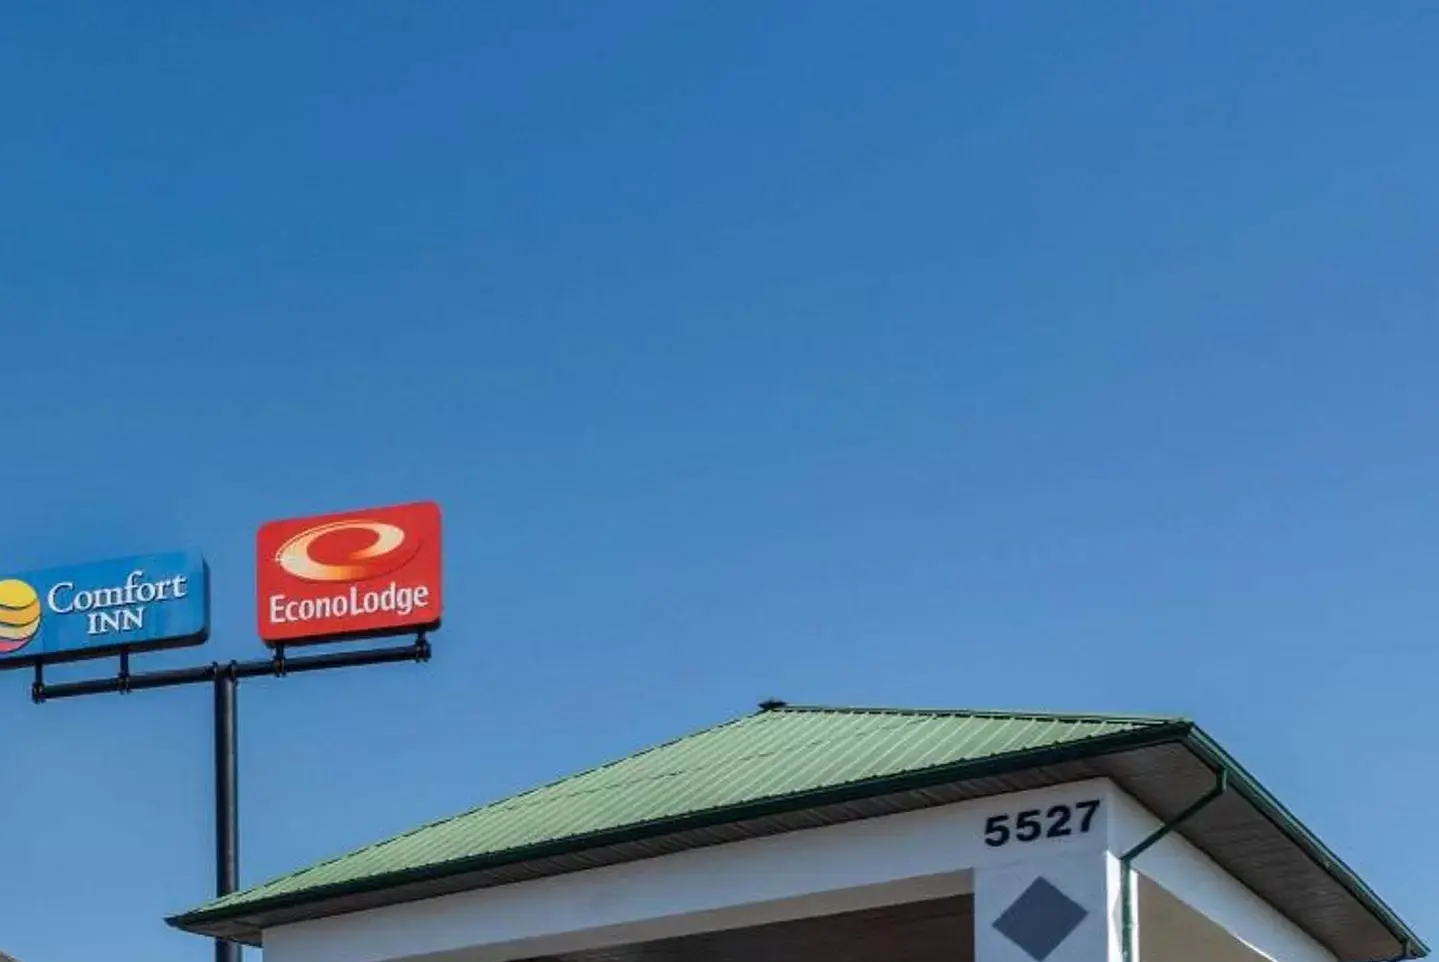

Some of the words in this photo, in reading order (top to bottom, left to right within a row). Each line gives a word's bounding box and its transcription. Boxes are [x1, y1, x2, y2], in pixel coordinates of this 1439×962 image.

[47, 570, 188, 613] Comfort
[269, 581, 429, 623] EconoLodge
[88, 607, 144, 634] INN
[984, 800, 1101, 847] 5527
